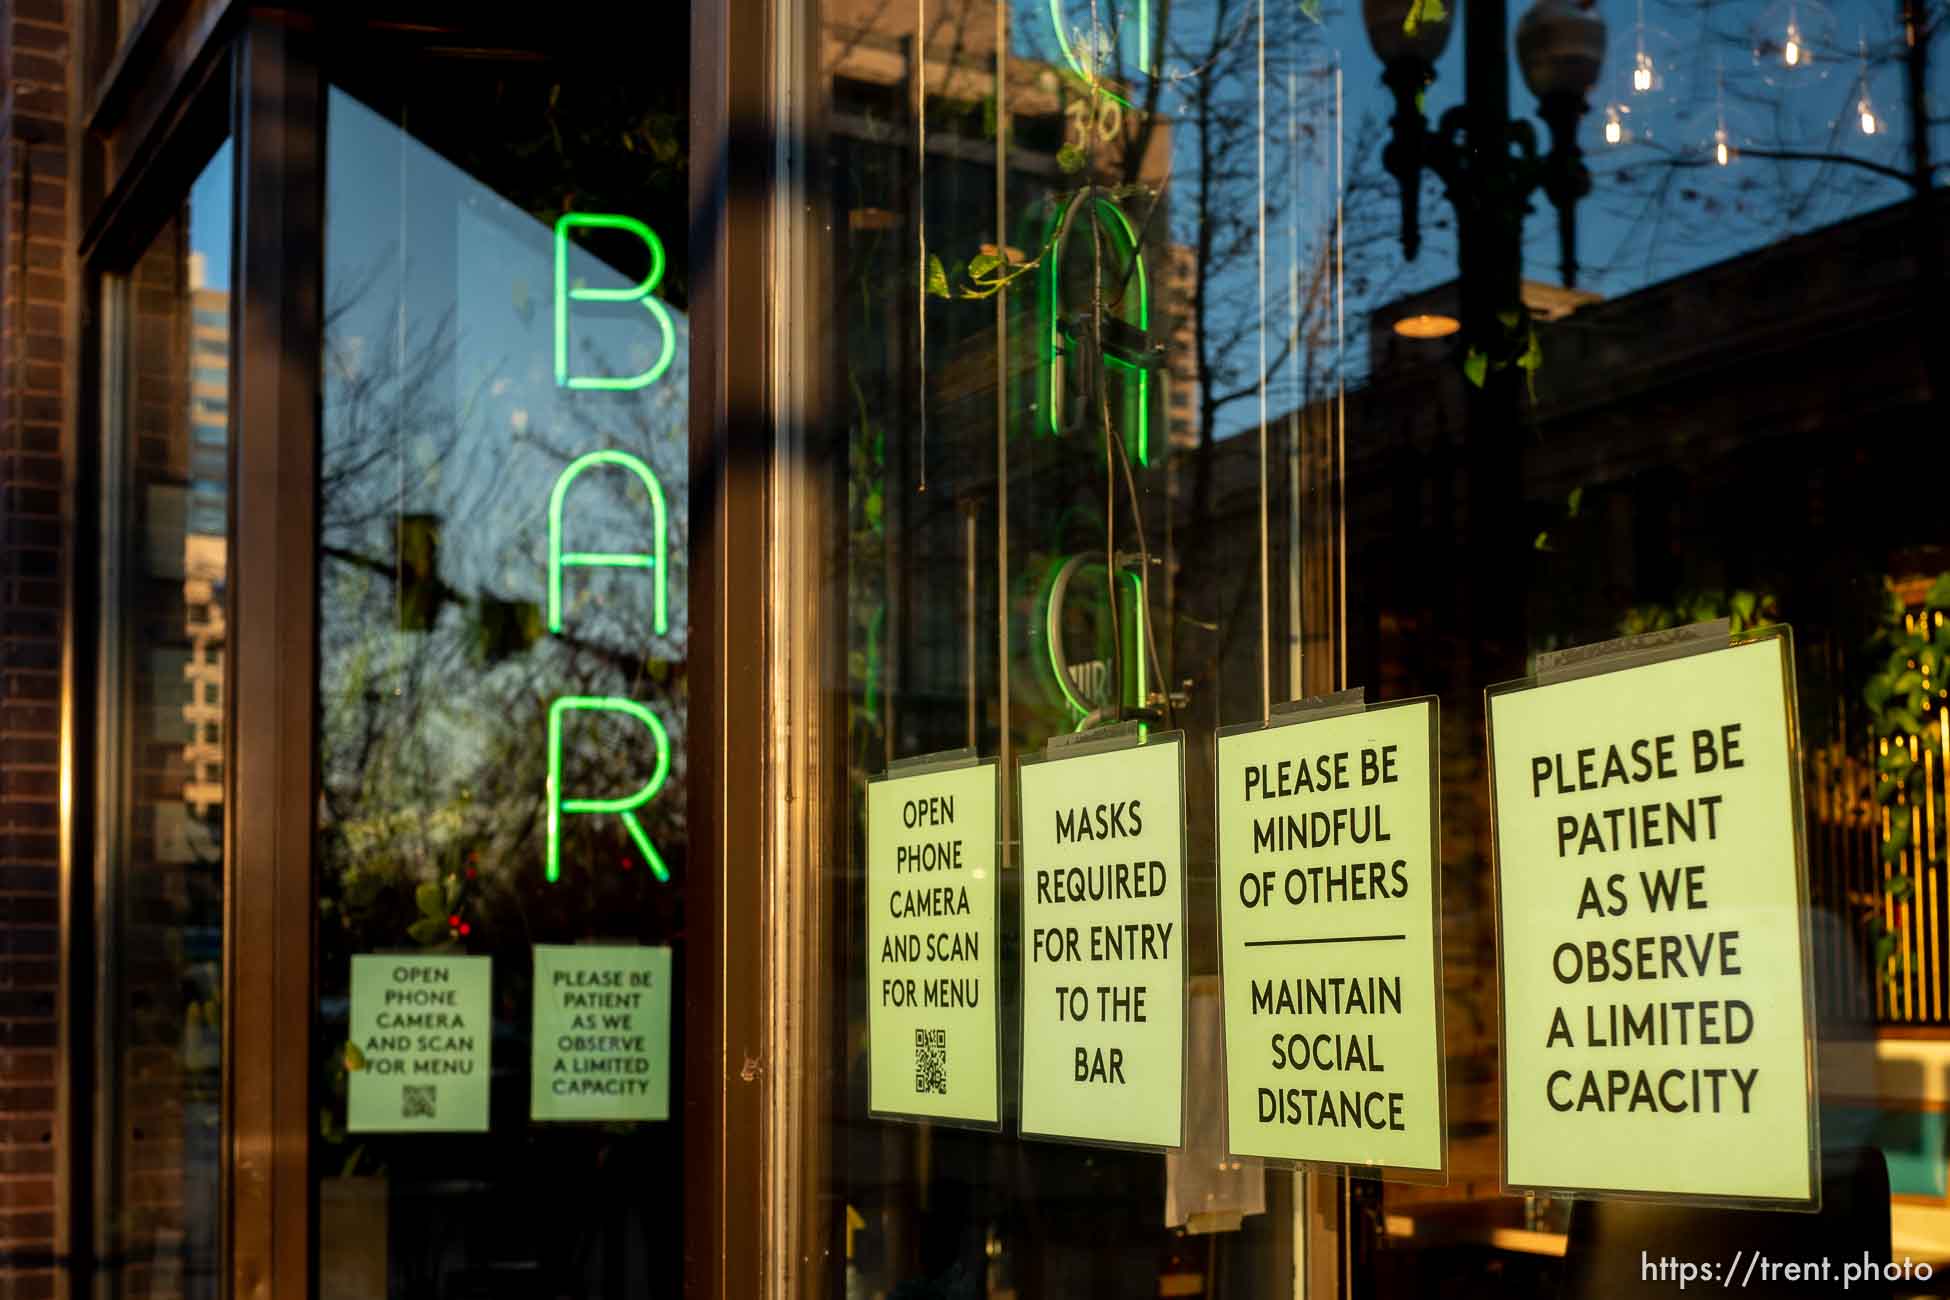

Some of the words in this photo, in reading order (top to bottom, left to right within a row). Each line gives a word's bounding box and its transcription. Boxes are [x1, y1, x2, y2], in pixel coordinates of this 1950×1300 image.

[548, 213, 676, 882] BAR
[1245, 752, 1349, 801] PLEASE
[1361, 745, 1398, 786] BE
[1532, 735, 1677, 798] PLEASE
[1693, 723, 1744, 773] BE
[904, 796, 953, 828] OPEN
[1056, 800, 1142, 844] MASKS
[1254, 805, 1390, 854] MINDFUL
[1558, 795, 1722, 857] PATIENT
[898, 840, 962, 873] PHONE
[1038, 861, 1166, 904] REQUIRED
[1240, 872, 1275, 908] OF
[1285, 860, 1408, 905] OTHERS
[1577, 874, 1627, 919] AS
[1640, 866, 1707, 912] WE
[890, 886, 970, 918] CAMERA
[882, 935, 920, 962] AND
[927, 932, 978, 962] SCAN
[1034, 928, 1081, 962] FOR
[1091, 923, 1173, 960] ENTRY
[1553, 931, 1741, 984] OBSERVE
[392, 966, 448, 983] OPEN
[553, 971, 622, 987] PLEASE
[630, 971, 651, 987] BE
[385, 989, 456, 1005] PHONE
[564, 992, 640, 1008] PATIENT
[883, 979, 917, 1007] FOR
[924, 979, 978, 1008] MENU
[1056, 987, 1088, 1021] TO
[1097, 987, 1146, 1022] THE
[1252, 977, 1401, 1014] MAINTAIN
[376, 1013, 464, 1029] CAMERA
[572, 1014, 596, 1030] AS
[603, 1014, 631, 1030] WE
[1546, 1007, 1574, 1048] A
[1588, 1000, 1754, 1047] LIMITED
[366, 1036, 411, 1051] AND
[418, 1036, 473, 1051] SCAN
[558, 1036, 645, 1052] OBSERVE
[1272, 1034, 1384, 1072] SOCIAL
[365, 1058, 405, 1075] FOR
[414, 1059, 473, 1074] MENU
[554, 1058, 566, 1072] A
[573, 1057, 649, 1074] LIMITED
[1075, 1047, 1125, 1084] BAR
[552, 1078, 649, 1095] CAPACITY
[1547, 1069, 1758, 1113] CAPACITY
[1259, 1088, 1405, 1130] DISTANCE
